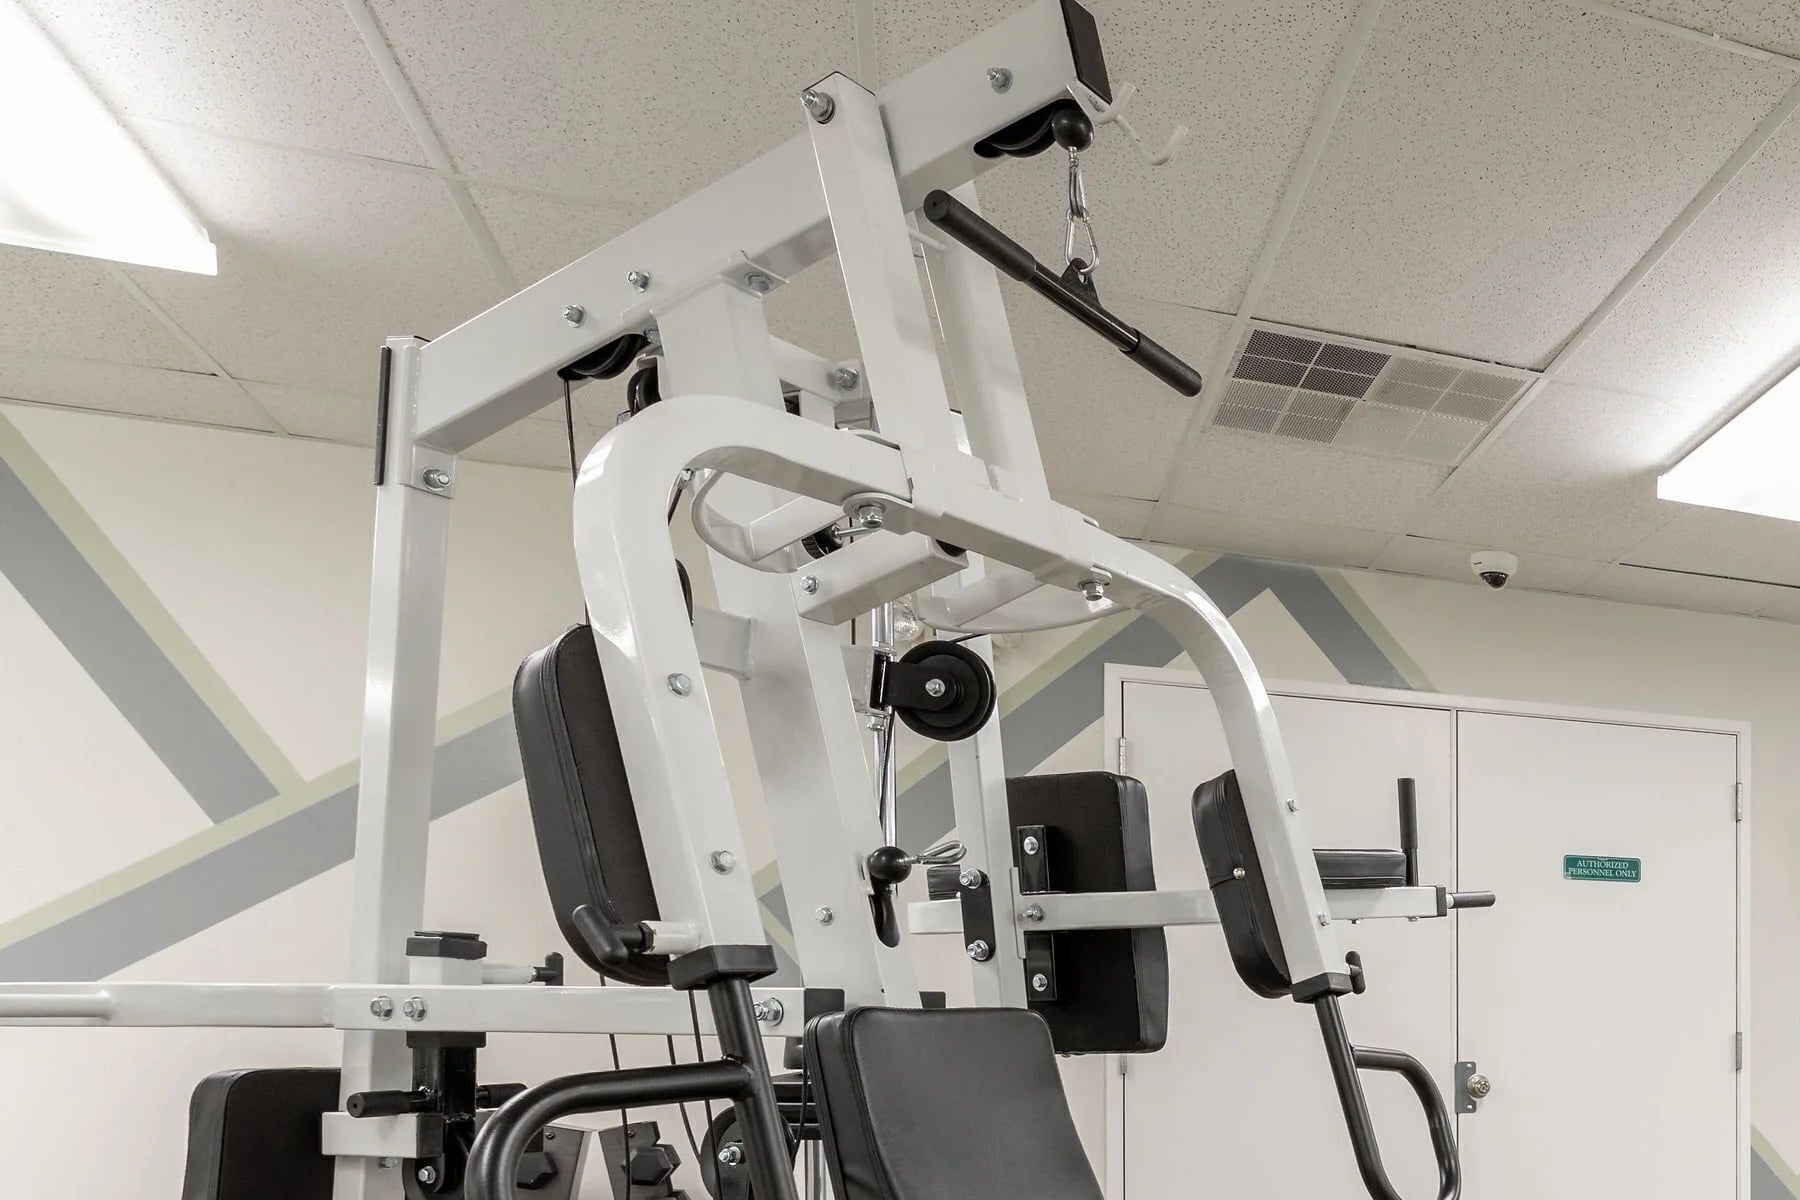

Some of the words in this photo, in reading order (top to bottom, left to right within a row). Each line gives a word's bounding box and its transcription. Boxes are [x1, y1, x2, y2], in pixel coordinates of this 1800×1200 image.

[1576, 860, 1629, 870] AUTHORIZED
[1568, 867, 1615, 877] PERSONNEL
[1615, 869, 1637, 878] ONLY
